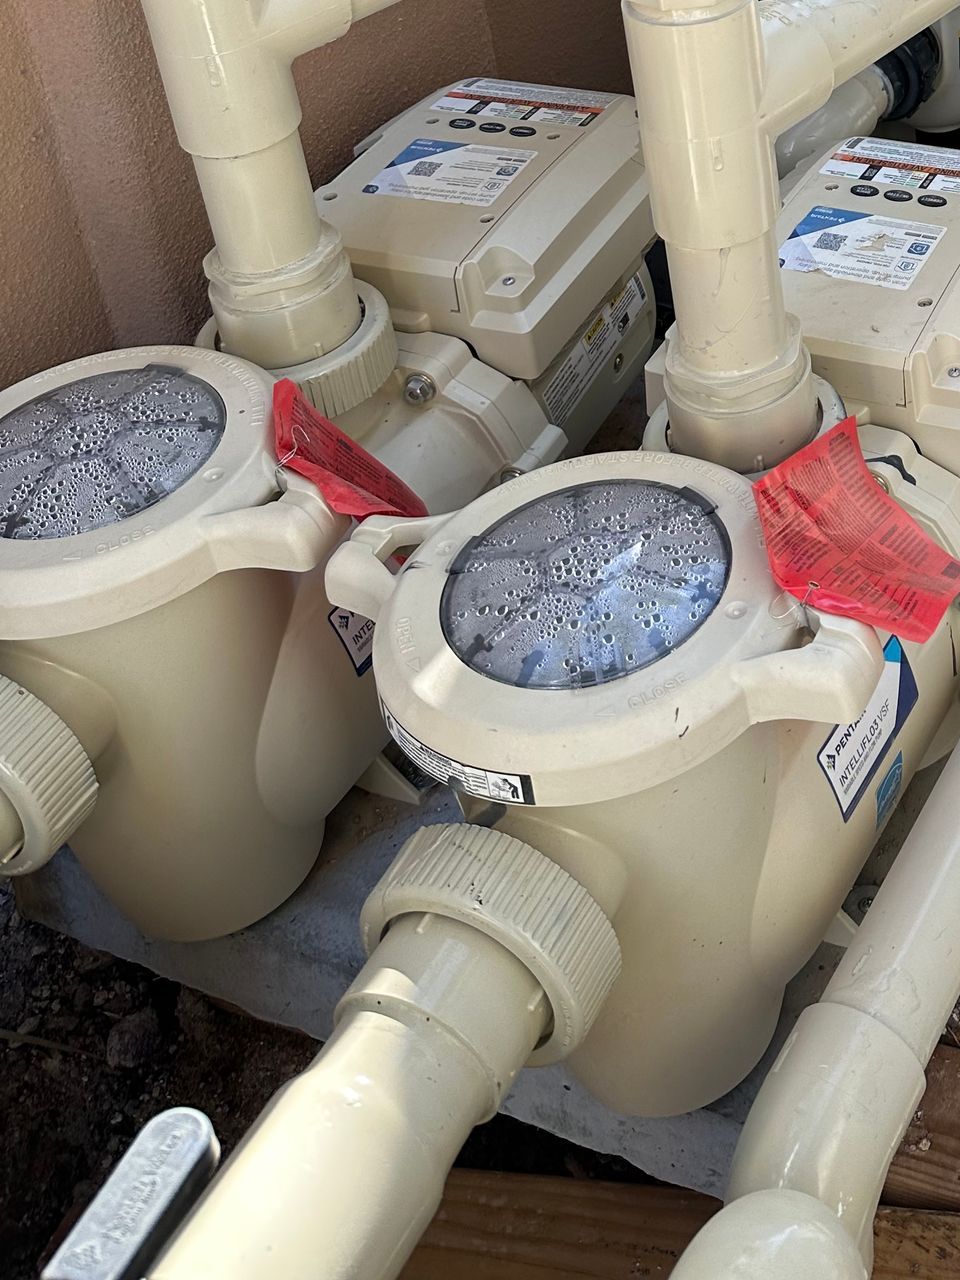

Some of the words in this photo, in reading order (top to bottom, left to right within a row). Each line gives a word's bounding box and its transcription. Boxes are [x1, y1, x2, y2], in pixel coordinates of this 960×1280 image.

[810, 213, 838, 221] PENTAIR
[890, 279, 908, 287] Scan
[633, 452, 695, 470] BEFORE
[95, 524, 155, 554] CLOSE
[627, 671, 690, 709] CLOSE
[838, 718, 880, 787] INTELLIFLO3
[876, 698, 891, 724] VSF
